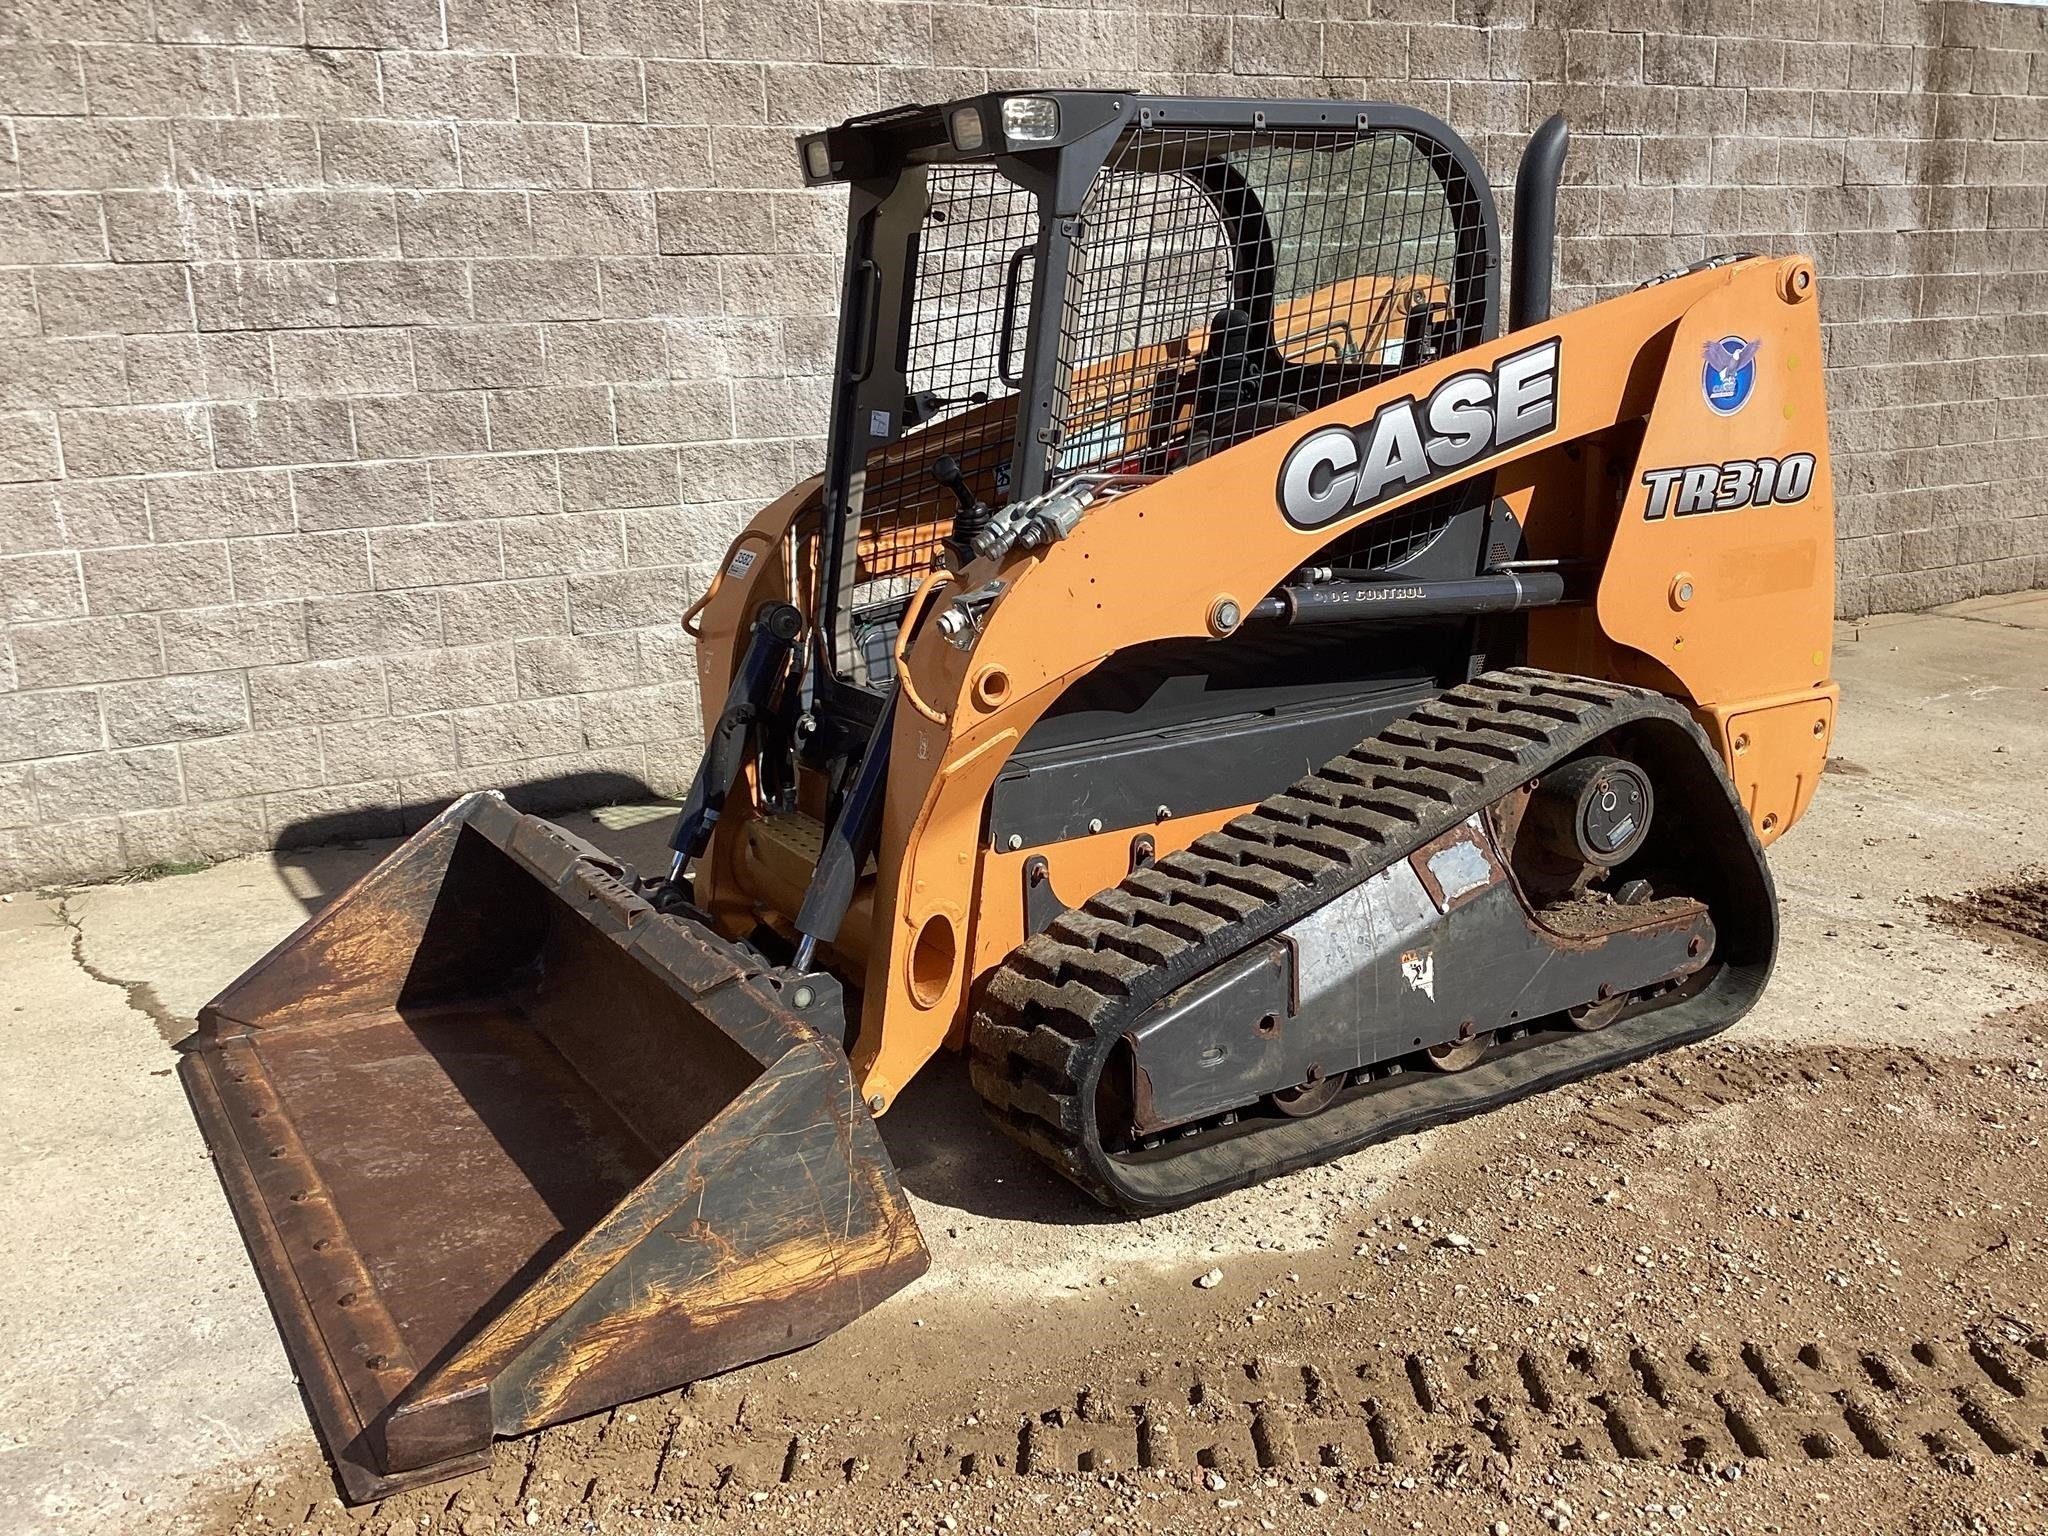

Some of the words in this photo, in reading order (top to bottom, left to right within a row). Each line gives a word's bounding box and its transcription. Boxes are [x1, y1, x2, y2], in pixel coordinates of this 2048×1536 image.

[1281, 338, 1558, 525] CASE
[1643, 453, 1815, 519] TR310
[1356, 586, 1426, 601] CONTROL
